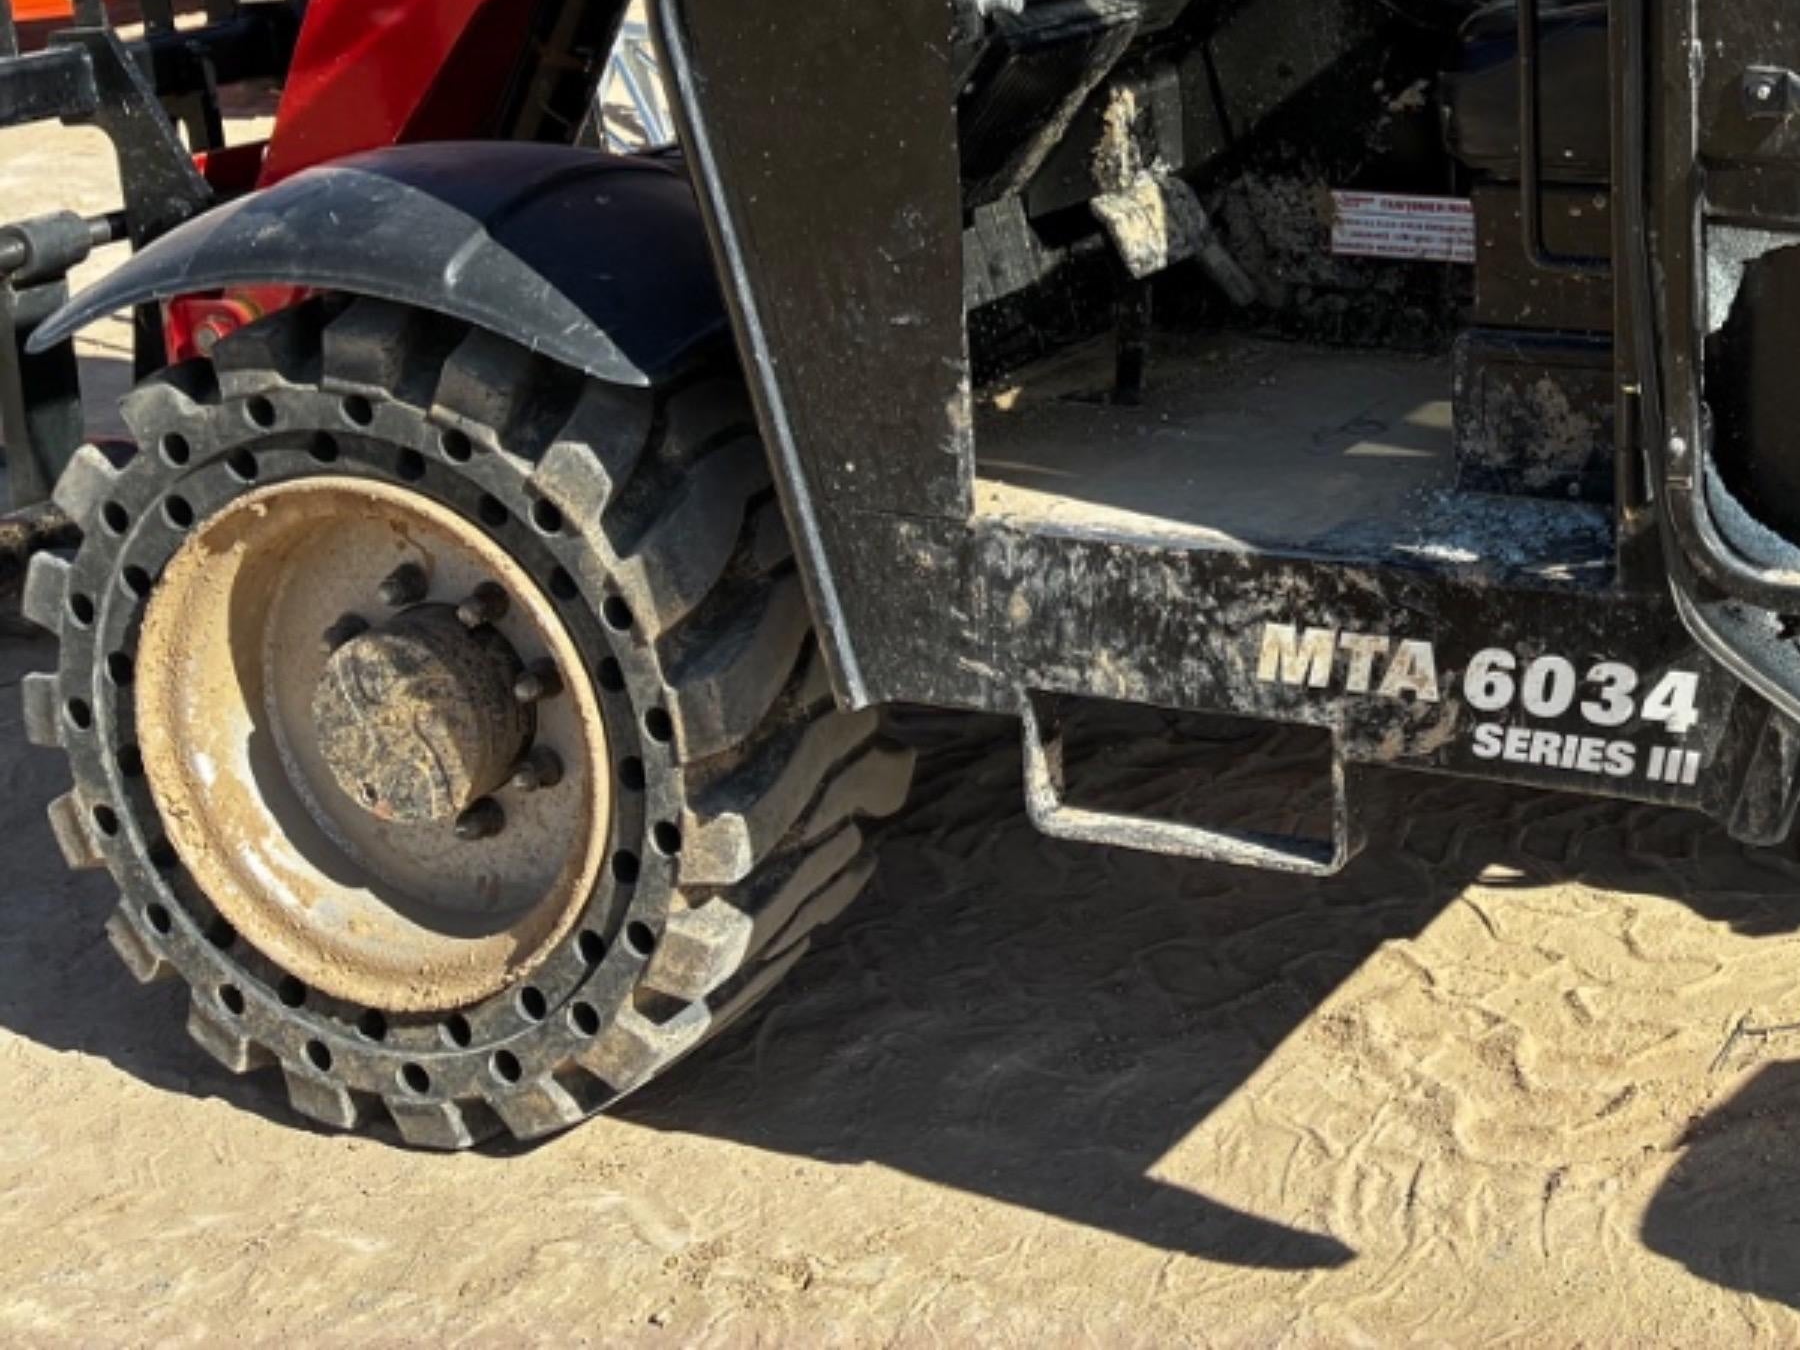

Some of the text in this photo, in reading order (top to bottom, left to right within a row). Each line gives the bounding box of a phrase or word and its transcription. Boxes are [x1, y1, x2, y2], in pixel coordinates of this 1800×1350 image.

[1256, 622, 1699, 733] MTA 6034
[1472, 722, 1701, 786] SERIES III
